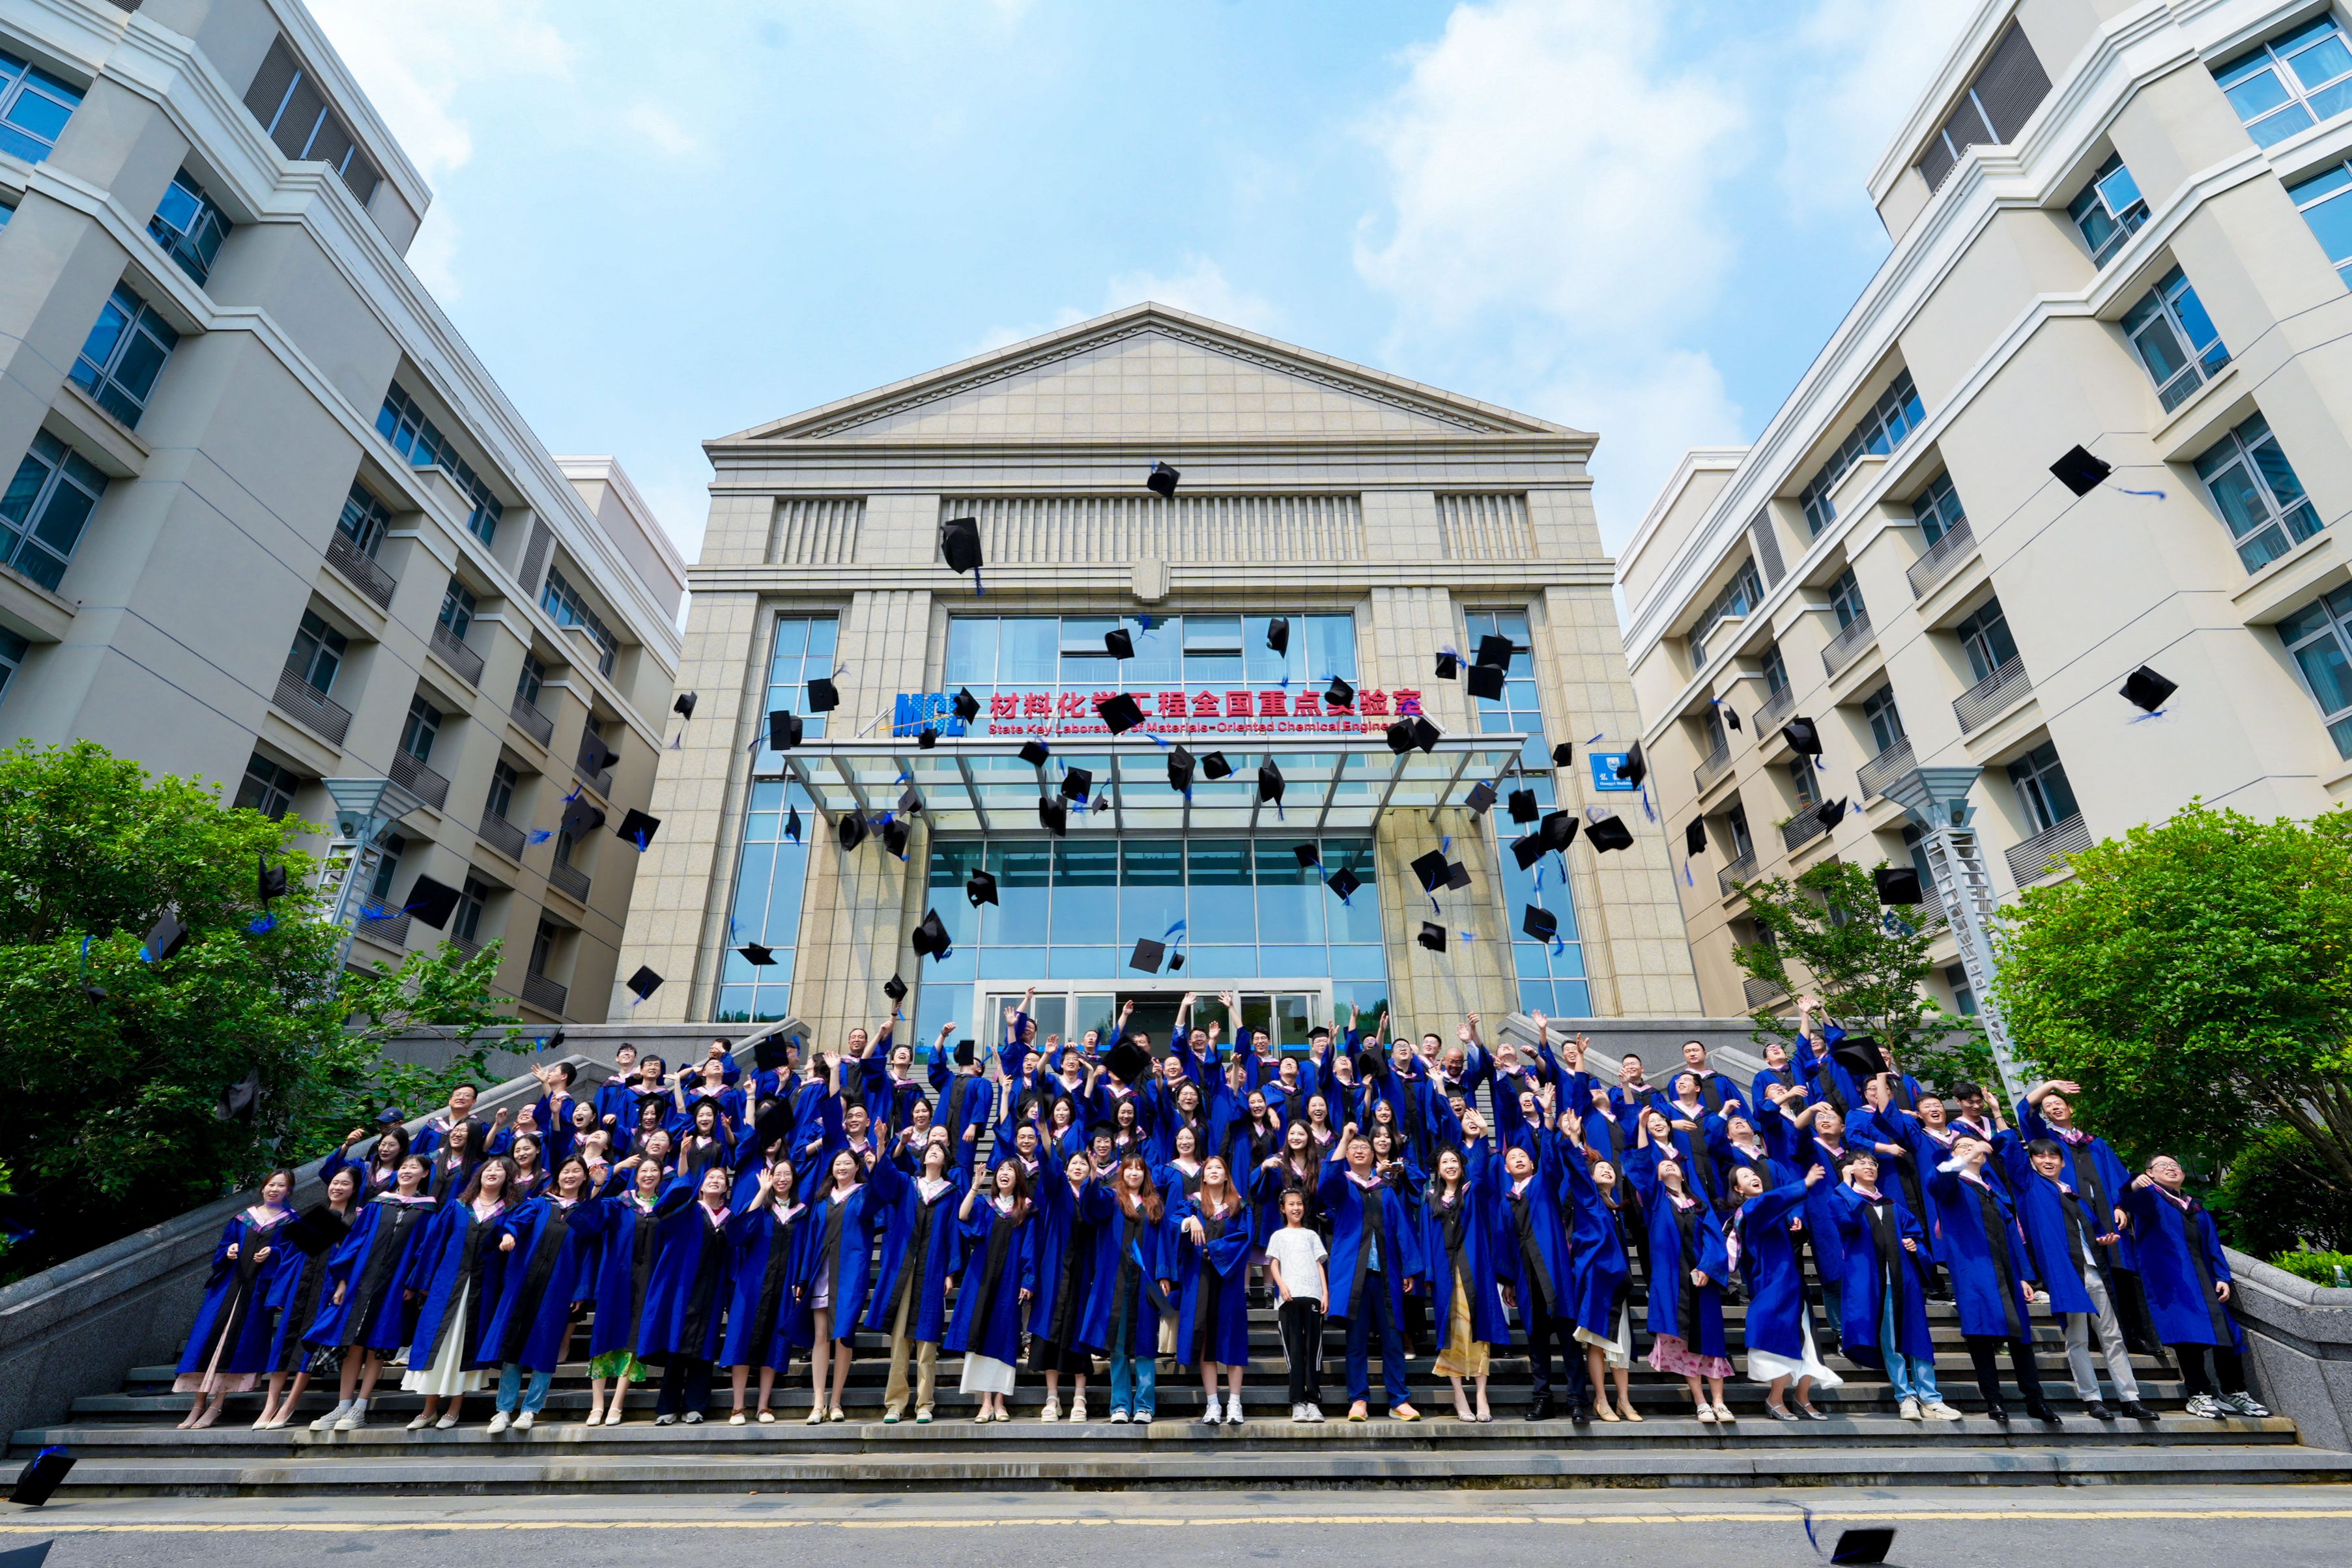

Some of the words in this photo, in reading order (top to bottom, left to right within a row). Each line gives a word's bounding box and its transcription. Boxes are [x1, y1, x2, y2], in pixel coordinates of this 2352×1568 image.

[989, 724, 1023, 734] State
[1027, 724, 1052, 736] Key
[1055, 723, 1126, 735] Laborat
[1130, 722, 1144, 733] of
[1146, 721, 1274, 733] Materials-Oriented
[1278, 720, 1340, 732] Chemical
